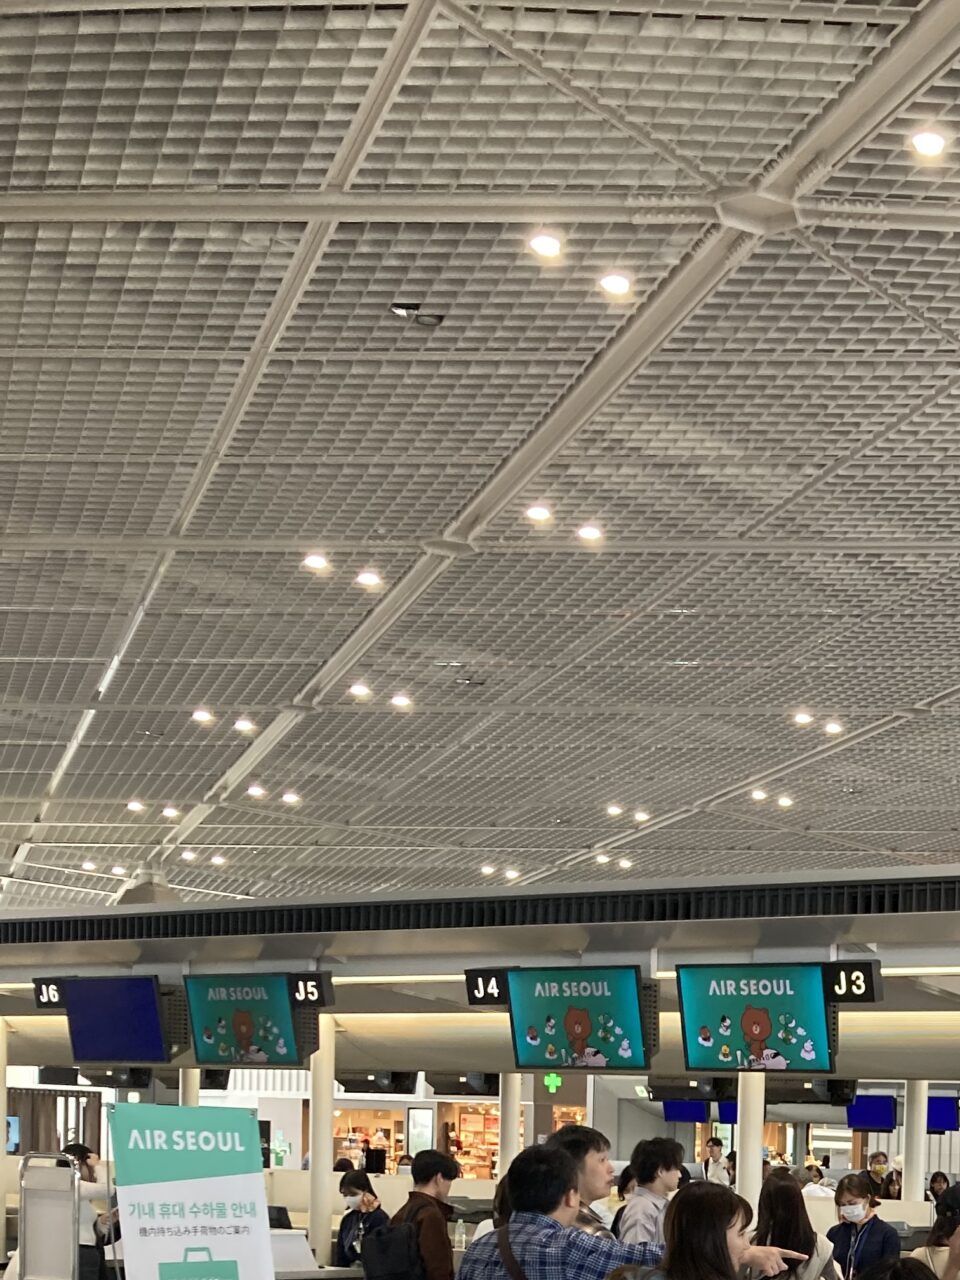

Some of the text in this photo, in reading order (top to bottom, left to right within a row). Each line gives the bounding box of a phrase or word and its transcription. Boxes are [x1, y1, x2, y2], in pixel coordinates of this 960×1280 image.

[295, 981, 319, 1001] J5
[473, 976, 500, 998] J4
[534, 981, 611, 998] AIR SEOUL
[708, 978, 794, 996] AIR SEOUL
[834, 971, 866, 996] J3
[39, 984, 59, 1002] J6
[207, 986, 268, 1001] AIR SEOUL
[128, 1129, 246, 1152] AIR SEOUL
[128, 1202, 257, 1219] 기내 휴대 수하물 안내
